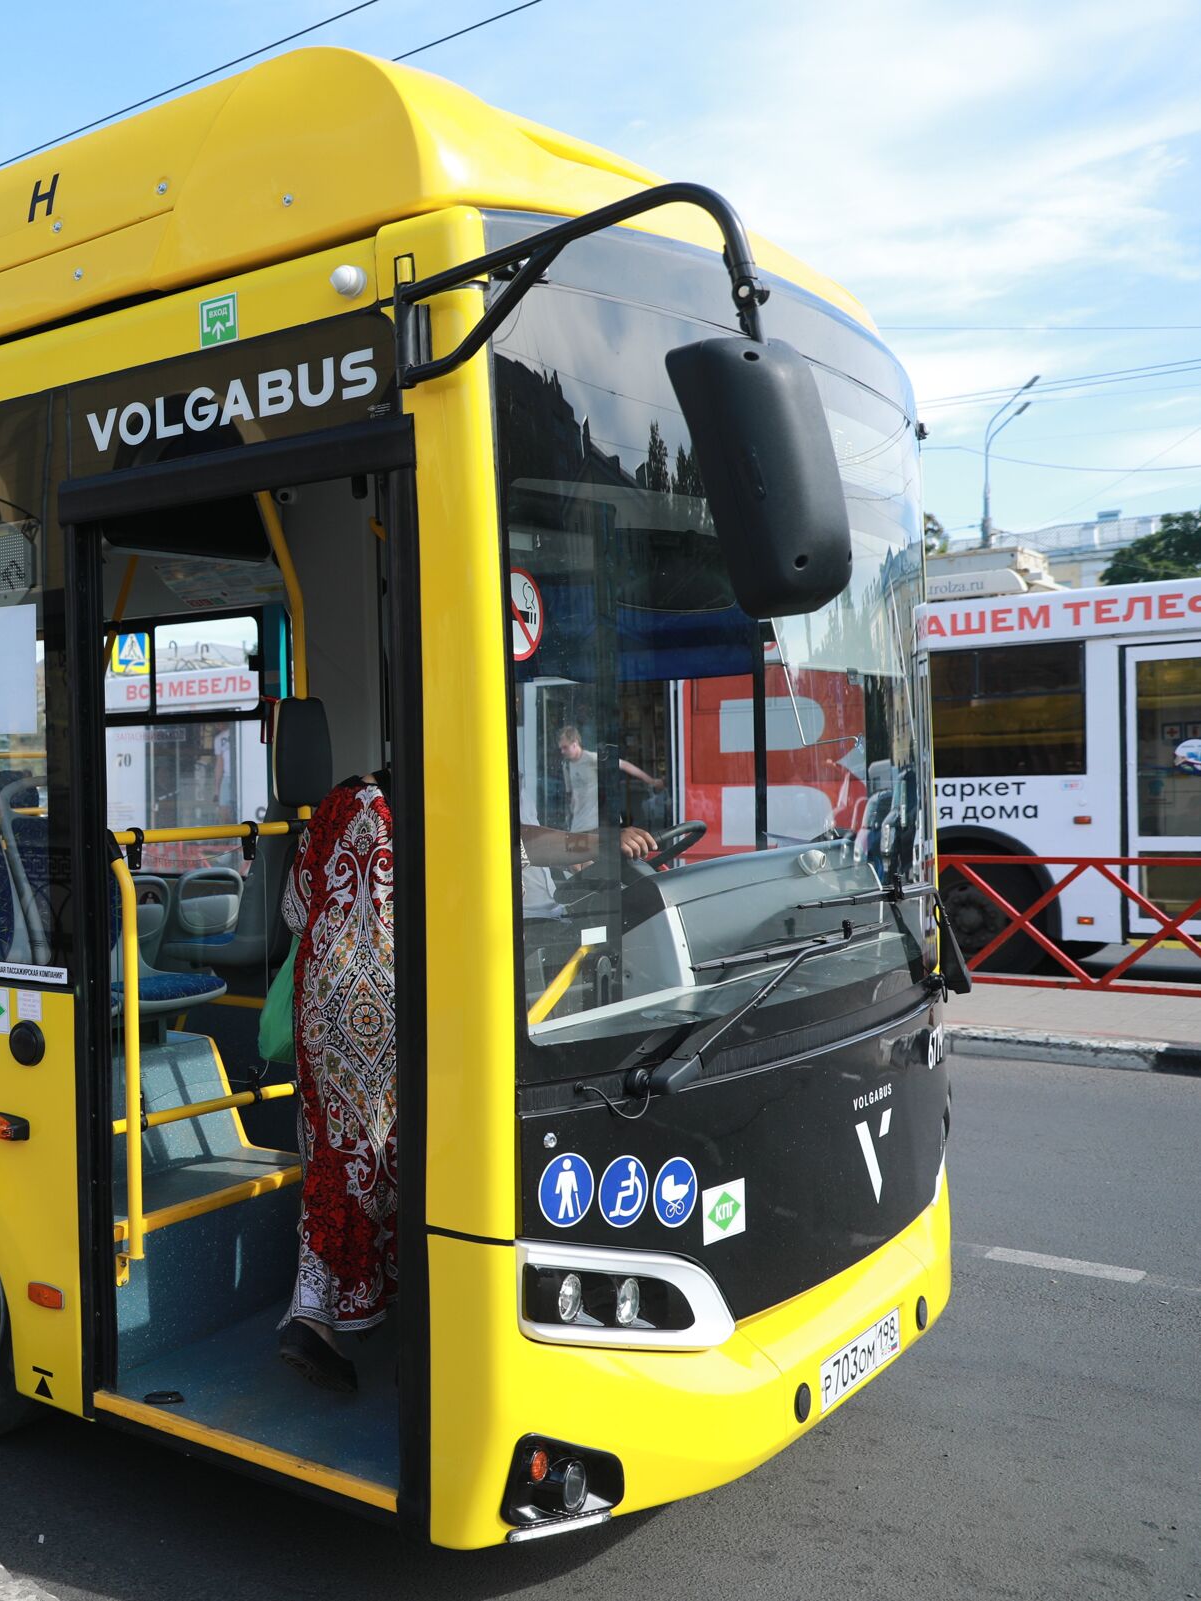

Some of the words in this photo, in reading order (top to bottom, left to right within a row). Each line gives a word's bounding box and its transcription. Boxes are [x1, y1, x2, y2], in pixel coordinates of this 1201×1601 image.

[208, 306, 228, 318] ВХОД
[86, 348, 378, 452] VOLGABUS
[926, 604, 1050, 638] АШЕМ
[169, 675, 252, 698] МЕБЕЛЬ
[116, 753, 132, 767] 70
[934, 781, 1027, 802] аркет
[962, 804, 1040, 823] дома
[6, 966, 38, 976] ПАССАЖИРСКАЯ
[853, 1082, 892, 1111] VOLGABUS
[715, 1200, 735, 1223] КПГ
